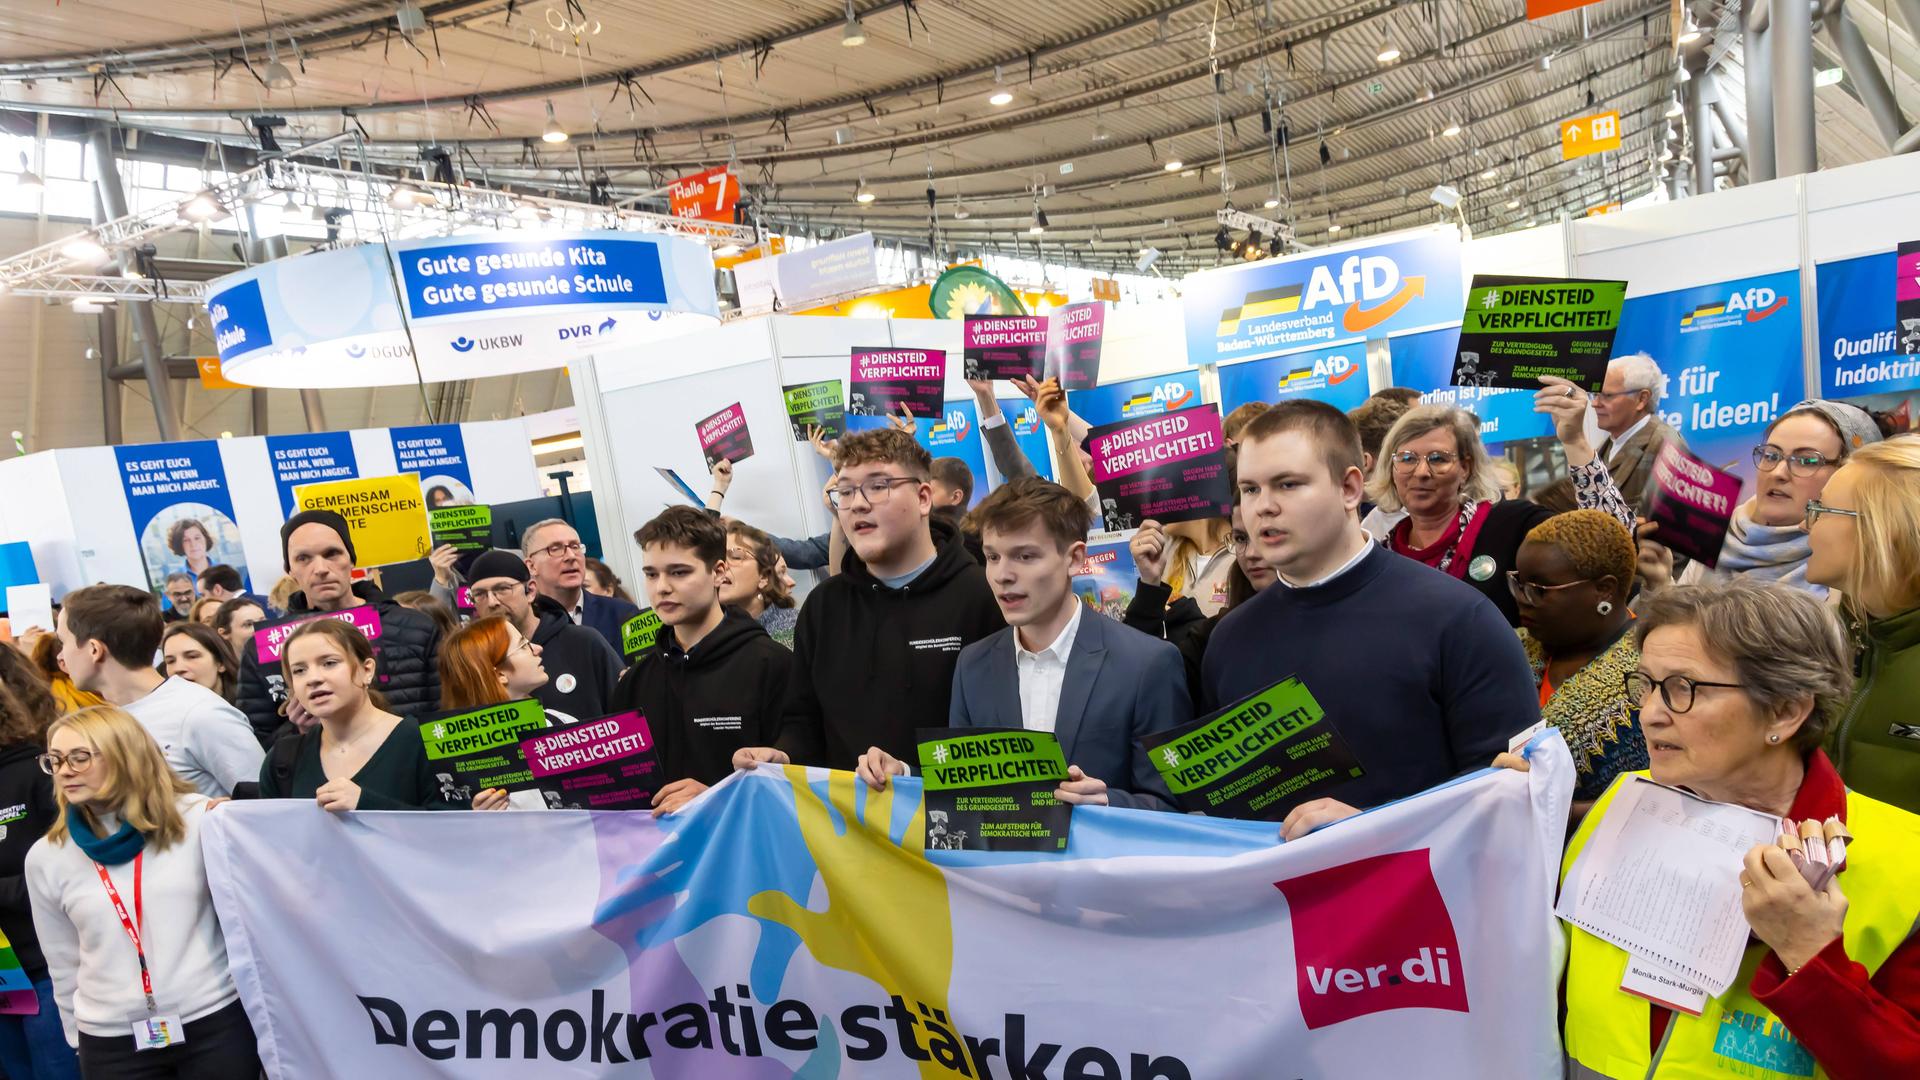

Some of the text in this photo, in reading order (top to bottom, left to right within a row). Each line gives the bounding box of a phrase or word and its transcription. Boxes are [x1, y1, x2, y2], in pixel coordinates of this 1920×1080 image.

[674, 172, 727, 211] Halle 7
[678, 202, 701, 219] Hall
[417, 245, 607, 277] Gute gesunde Kita
[422, 272, 634, 306] Gute gesunde Schule
[1303, 256, 1400, 310] AfD
[1482, 289, 1595, 310] #DIENSTEID
[1726, 288, 1776, 313] AfD
[972, 319, 1038, 335] #DIENSTEID
[1248, 311, 1334, 335] Landesverband
[1478, 310, 1612, 329] VERPFLICHTET!
[479, 334, 523, 351] UKBW
[558, 324, 592, 340] DVR
[1216, 325, 1335, 353] Baden-Württemberg
[372, 345, 412, 358] DGUV
[1503, 348, 1558, 357] GRUNDGESETZES
[1506, 341, 1553, 350] VERTEIDIGUNG
[859, 352, 927, 367] #DIENSTEID
[1312, 355, 1350, 377] AfD
[859, 366, 940, 379] VERPFLICHTET!
[1678, 365, 1720, 397] für
[1152, 382, 1185, 403] AfD
[1460, 386, 1475, 399] ist
[790, 395, 840, 412] VERPFLICHTET!
[1692, 392, 1779, 430] Ideen!
[702, 409, 733, 437] #DIENSTEID
[947, 410, 966, 430] AfD
[1025, 406, 1037, 424] AfD
[703, 415, 744, 445] VERPFLICHTET!
[1101, 416, 1189, 457] #DIENSTEID
[275, 447, 329, 459] ES GEHT EUCH
[397, 438, 442, 449] ES GEHT EUCH
[400, 450, 416, 458] ALLE
[428, 448, 447, 456] WENN
[1102, 431, 1215, 475] VERPFLICHTET!
[125, 457, 191, 471] ES GEHT EUCH
[278, 461, 297, 470] ALLE
[312, 458, 335, 467] WENN
[402, 460, 418, 469] MAN
[419, 458, 436, 467] MICH
[129, 469, 199, 484] ALLE AN, WENN
[280, 472, 300, 481] MAN
[300, 470, 321, 479] MICH
[132, 479, 219, 496] MAN MICH ANGEHT.
[304, 489, 390, 509] GEMEINSAM
[340, 499, 421, 518] MENSCHEN-
[431, 516, 487, 529] ERPFLICHTET!
[626, 629, 658, 650] VERPFLI
[432, 708, 520, 739] #DIENSTEID
[534, 720, 620, 757] #DIENSTEID
[1163, 701, 1273, 768] #DIENSTEID
[1286, 732, 1333, 755] GEGEN HASS
[538, 732, 646, 771] VERPFLICHTET!
[932, 738, 1035, 764] #DIENSTEID
[1171, 706, 1313, 787] VERPFLICHTET!
[1289, 740, 1330, 760] UND HETZE
[934, 759, 1062, 784] VERPFLICHTET!
[1206, 765, 1271, 800] ZUR VERTEIDIGUNG
[1209, 766, 1282, 807] DES GRUNDGESETZES
[1248, 766, 1319, 807] ZUM AUFSTEHEN FÜR
[1251, 768, 1336, 812] DEMOKRATISCHE WERTE
[968, 803, 1020, 811] GRUNDGESETZES
[969, 796, 1014, 804] VERTEIDIGUNG
[980, 830, 1051, 838] DEMOKRATISCHE WERTE
[1031, 821, 1042, 830] FÜR
[1306, 946, 1451, 995] ver.di
[1632, 967, 1704, 996] Monika Stark-Murgia
[356, 983, 1192, 1080] Demokratie stärken
